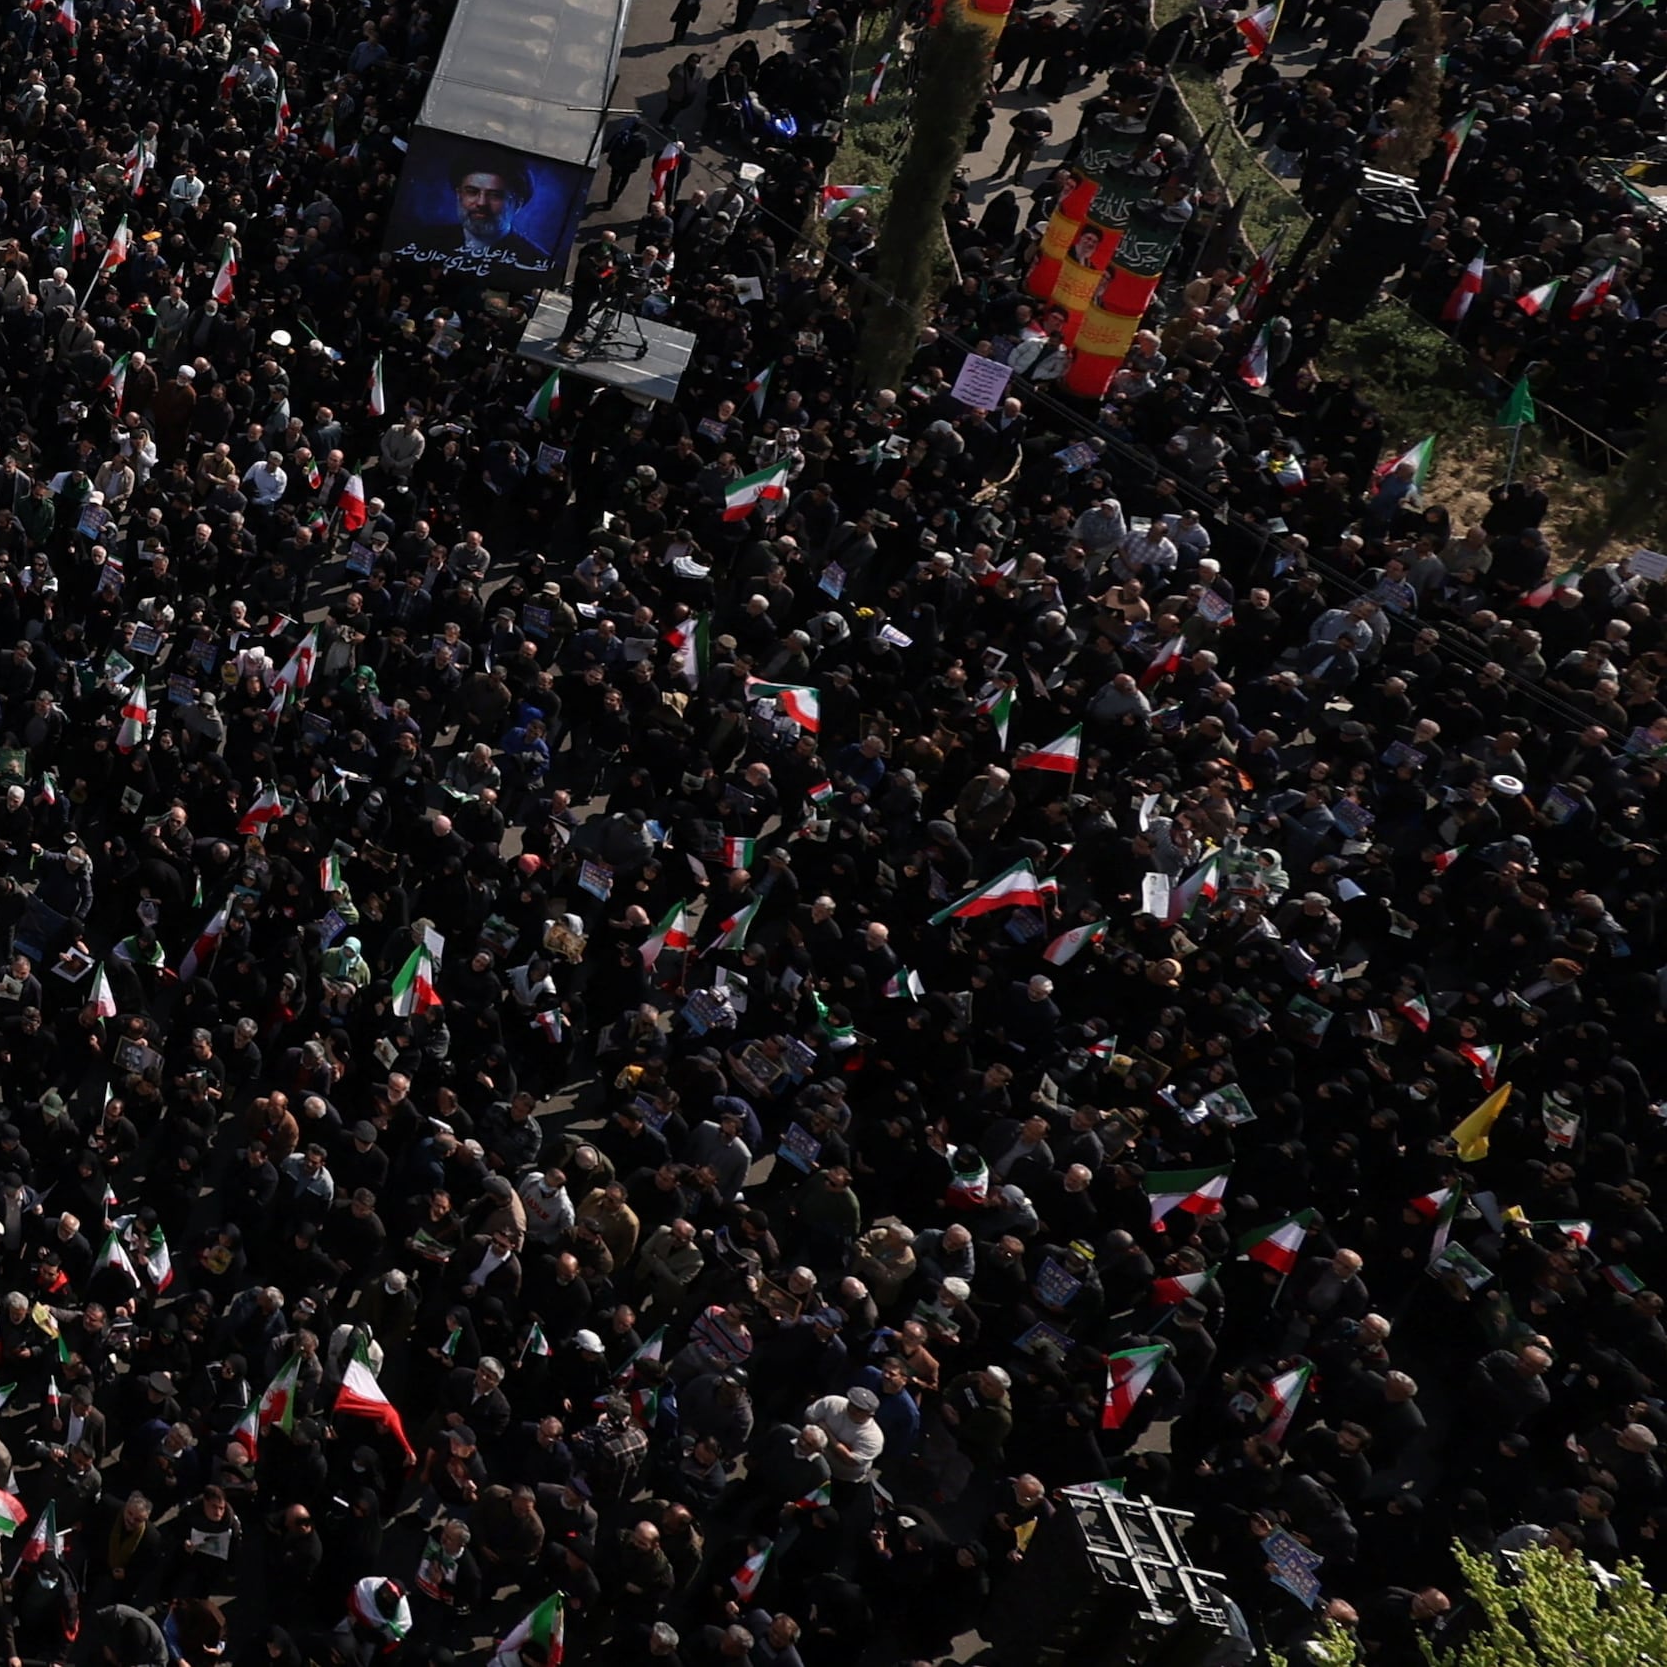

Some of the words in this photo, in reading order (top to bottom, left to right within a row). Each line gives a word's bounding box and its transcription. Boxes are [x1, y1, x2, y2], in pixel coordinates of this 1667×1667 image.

[393, 242, 417, 256] شد
[454, 240, 473, 253] شد
[471, 247, 502, 262] عیان
[500, 248, 517, 264] خدا
